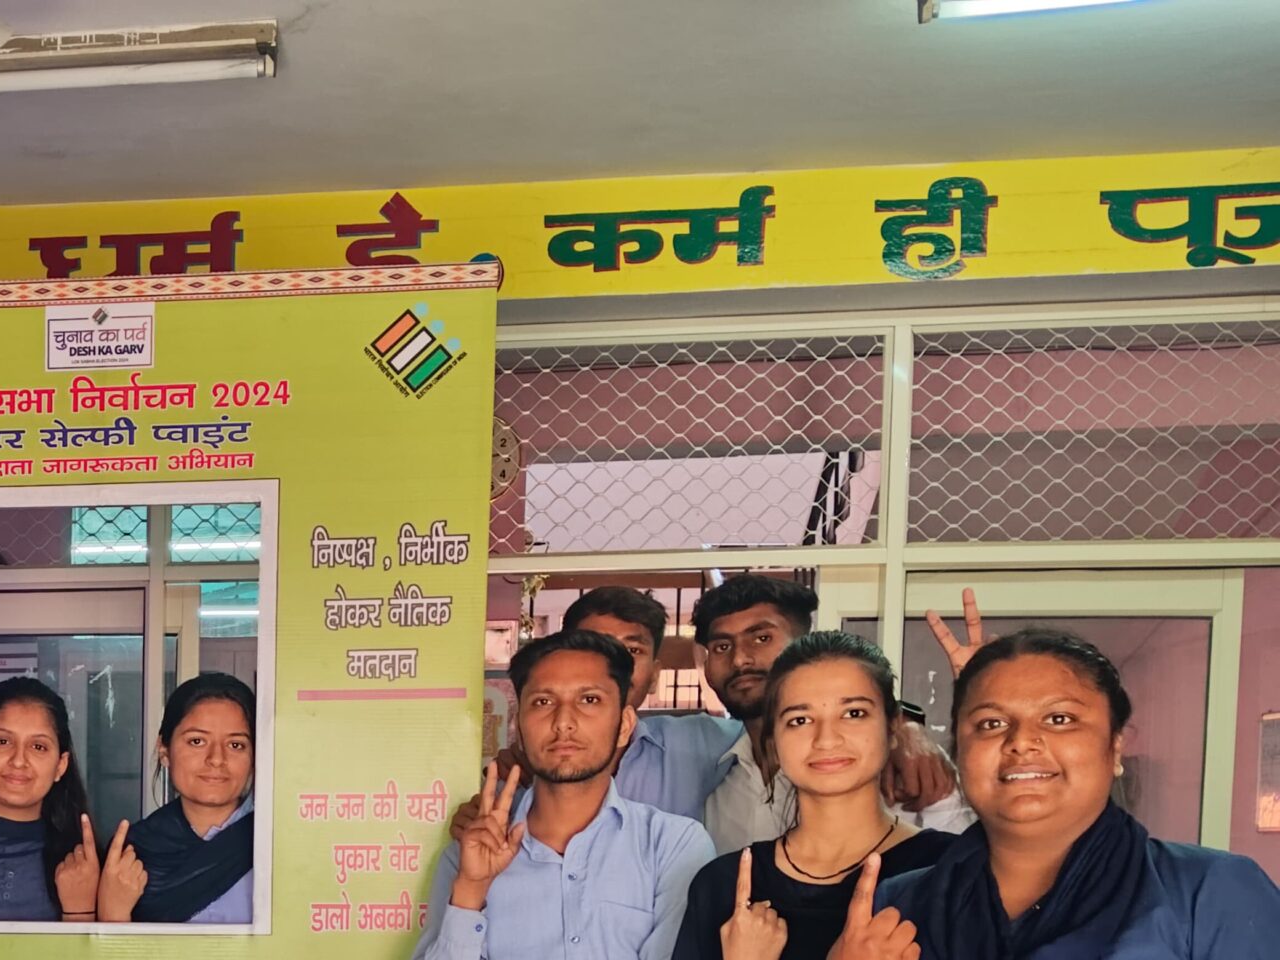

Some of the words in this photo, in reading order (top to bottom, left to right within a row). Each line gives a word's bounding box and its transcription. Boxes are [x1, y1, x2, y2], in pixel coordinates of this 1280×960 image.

[544, 185, 776, 272] कर्म
[874, 176, 999, 281] ही
[53, 330, 95, 351] चुनाव
[98, 328, 120, 343] का
[123, 322, 148, 342] पर्व
[69, 345, 96, 357] DESH
[98, 345, 113, 355] KA
[114, 344, 145, 355] GARV
[70, 373, 197, 413] निर्वाचन
[211, 380, 291, 409] 2024
[40, 416, 137, 448] सेल्फी
[152, 415, 252, 449] प्वाइंट
[500, 438, 507, 448] 2
[42, 455, 159, 475] जागरूकता
[167, 448, 255, 472] अभियान
[499, 469, 506, 479] 4
[311, 525, 377, 569] निष्पक्ष
[398, 520, 470, 566] निर्भीक
[324, 584, 384, 631] होकर
[388, 581, 453, 627] नैतिक
[347, 648, 418, 682] मतदान
[373, 780, 399, 820] की
[406, 780, 448, 823] यही
[334, 845, 383, 884] पुकार
[389, 832, 421, 872] वोट
[311, 891, 351, 932] डालो
[358, 891, 412, 930] अबकी
